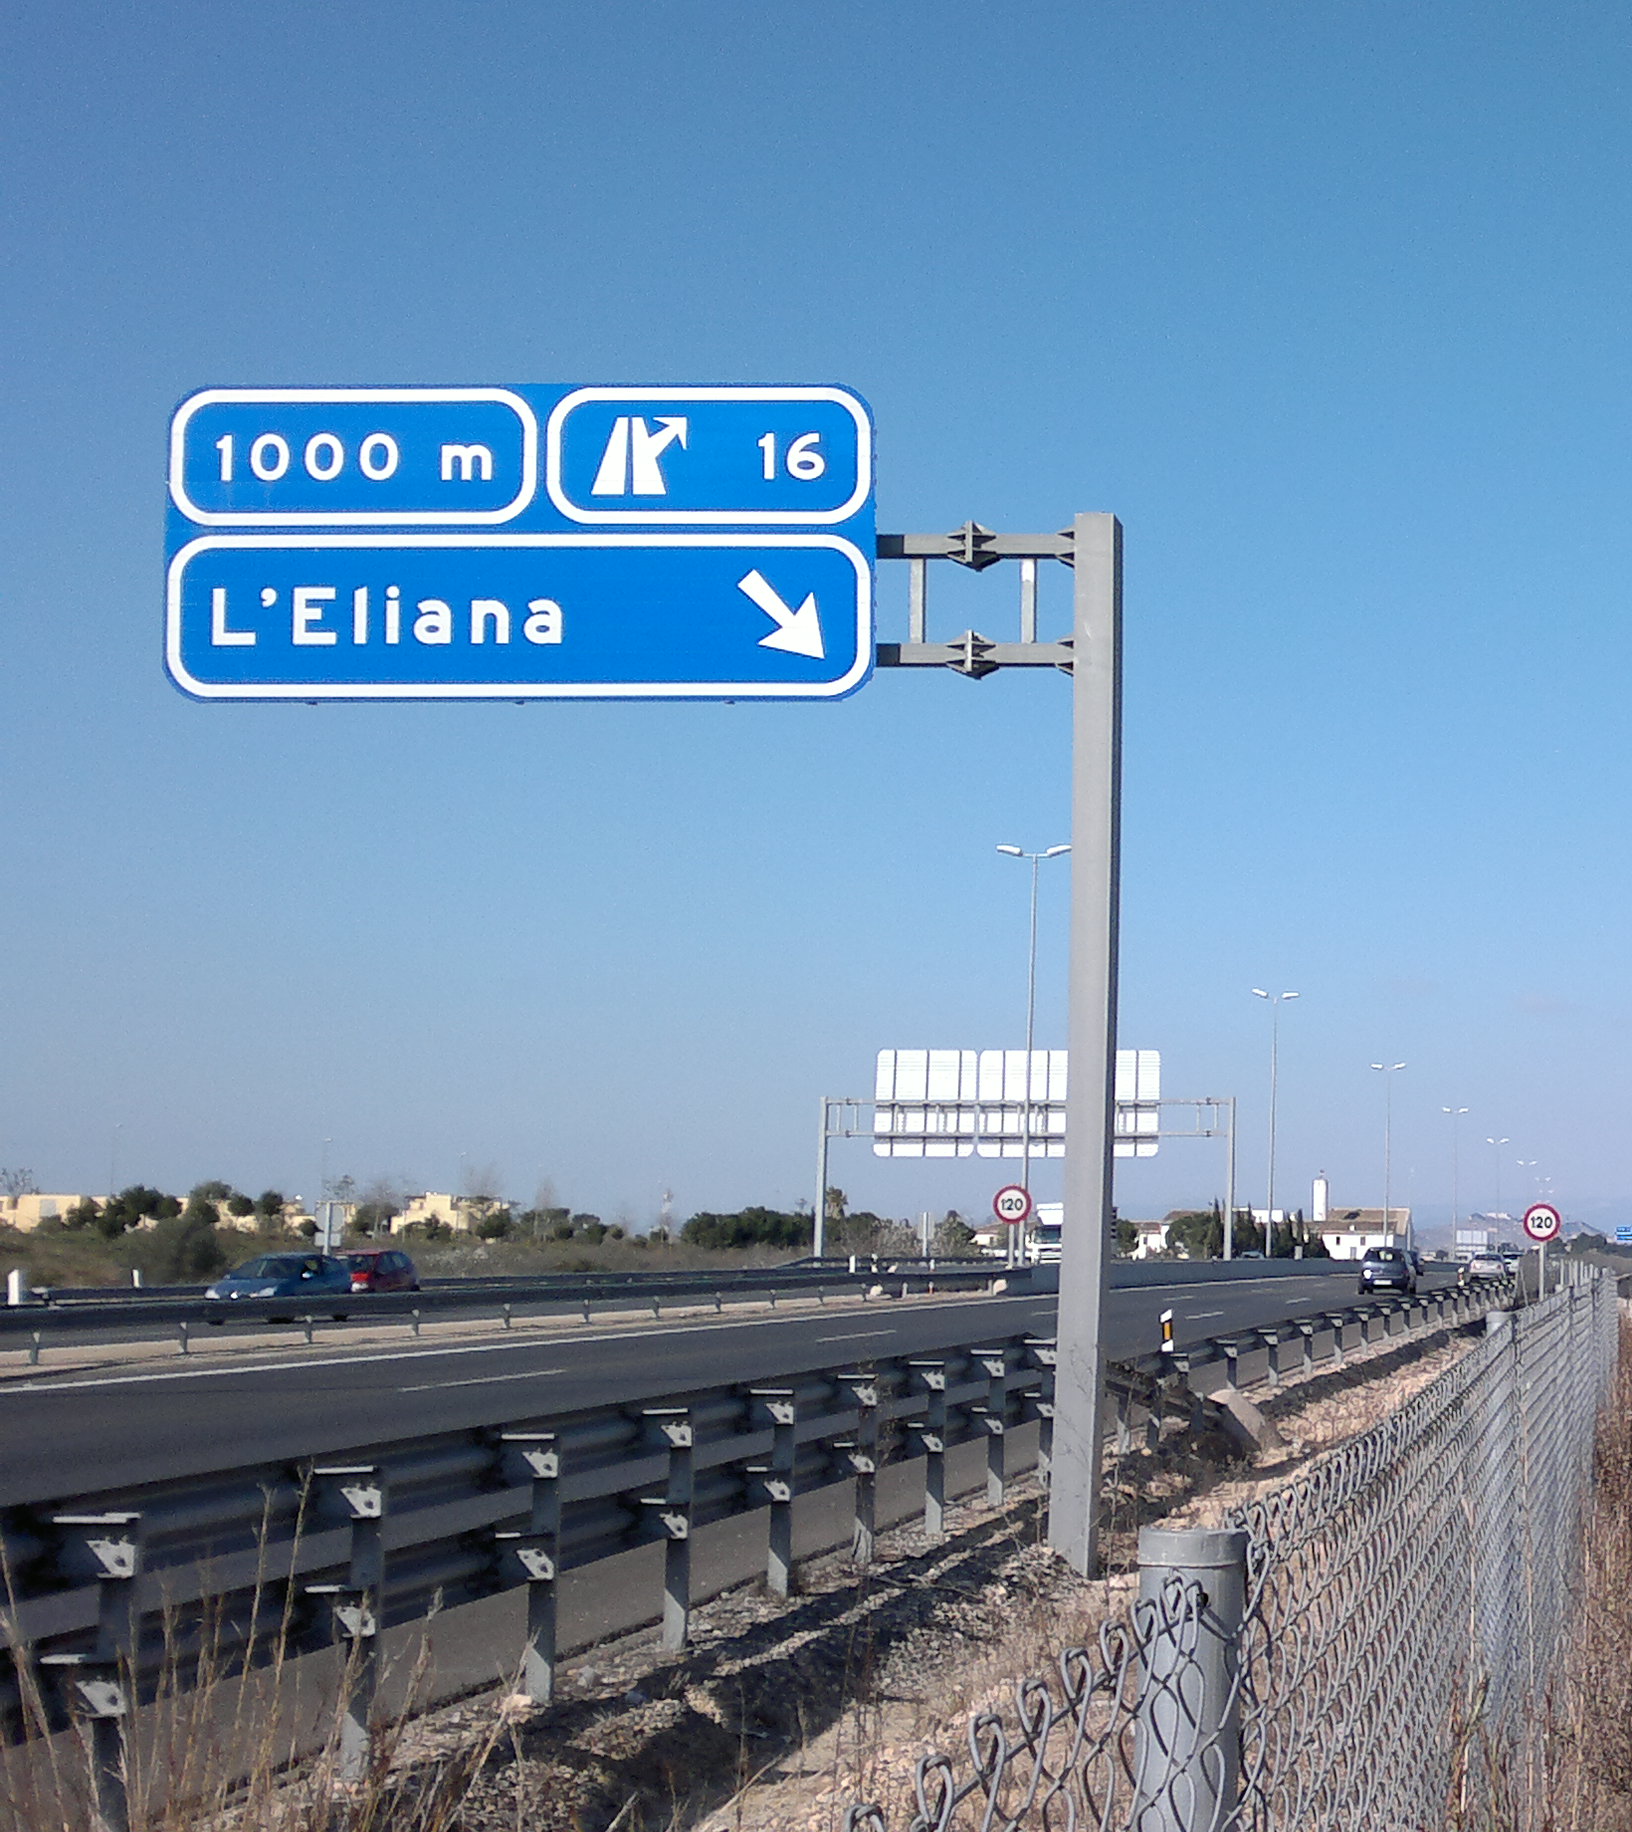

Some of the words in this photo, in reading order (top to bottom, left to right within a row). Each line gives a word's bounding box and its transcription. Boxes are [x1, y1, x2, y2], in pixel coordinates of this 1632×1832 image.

[214, 433, 400, 481] 1000
[440, 442, 493, 481] m
[756, 432, 826, 481] 16
[211, 586, 564, 646] L'Eliana
[1001, 1198, 1023, 1211] 120
[1531, 1216, 1553, 1229] 120
